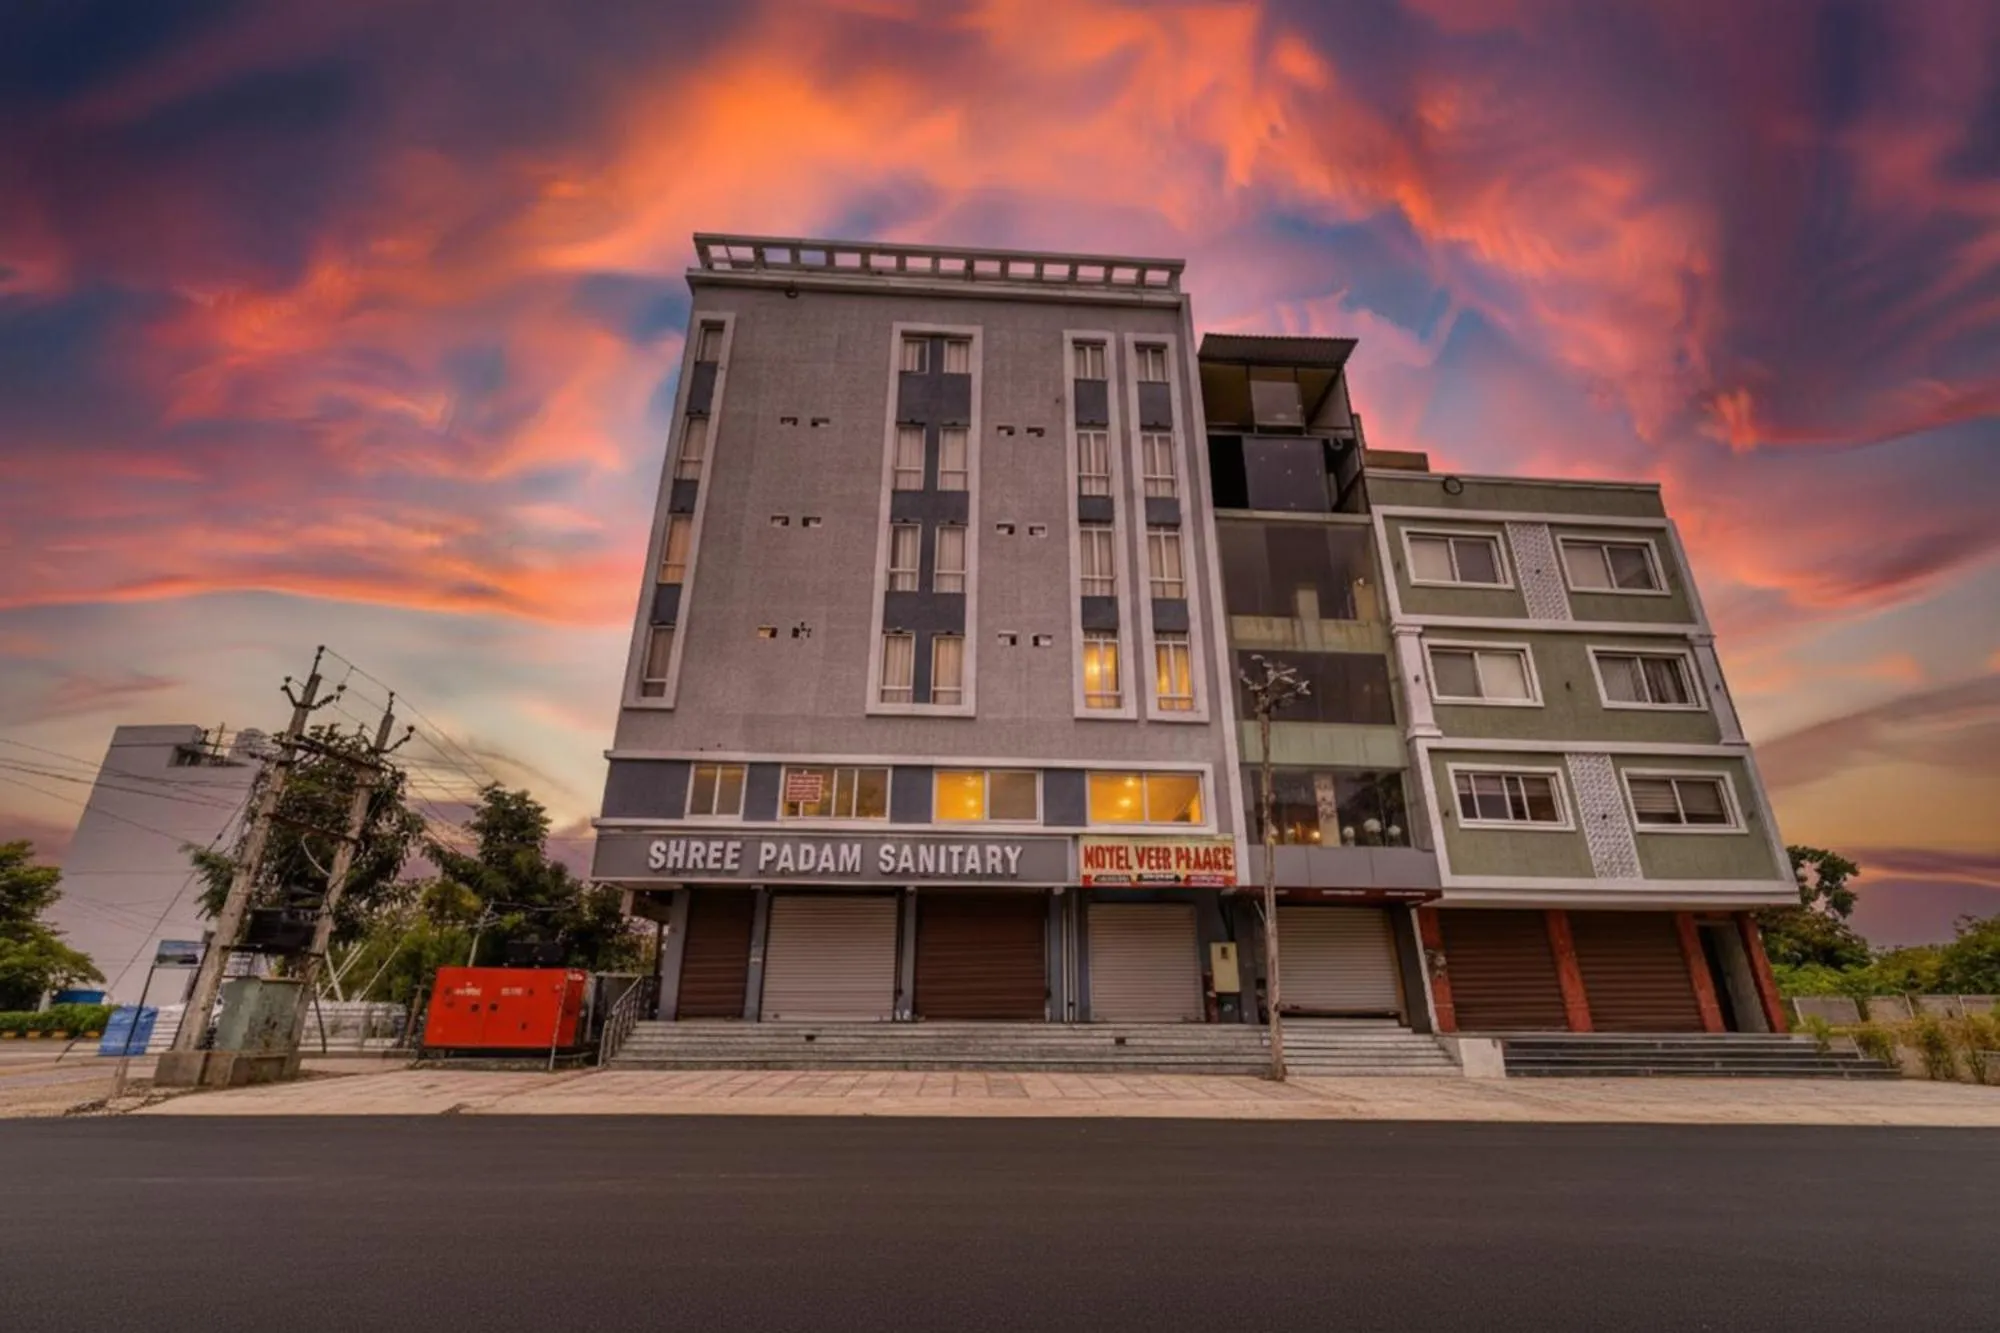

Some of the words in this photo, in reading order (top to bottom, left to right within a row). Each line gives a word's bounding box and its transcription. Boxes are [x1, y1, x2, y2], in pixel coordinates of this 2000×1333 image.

[649, 839, 742, 870] SHREE
[758, 841, 862, 873] PADAM
[878, 843, 1023, 875] SANITARY
[1083, 845, 1132, 870] HOTEL
[1134, 846, 1171, 870] VEER
